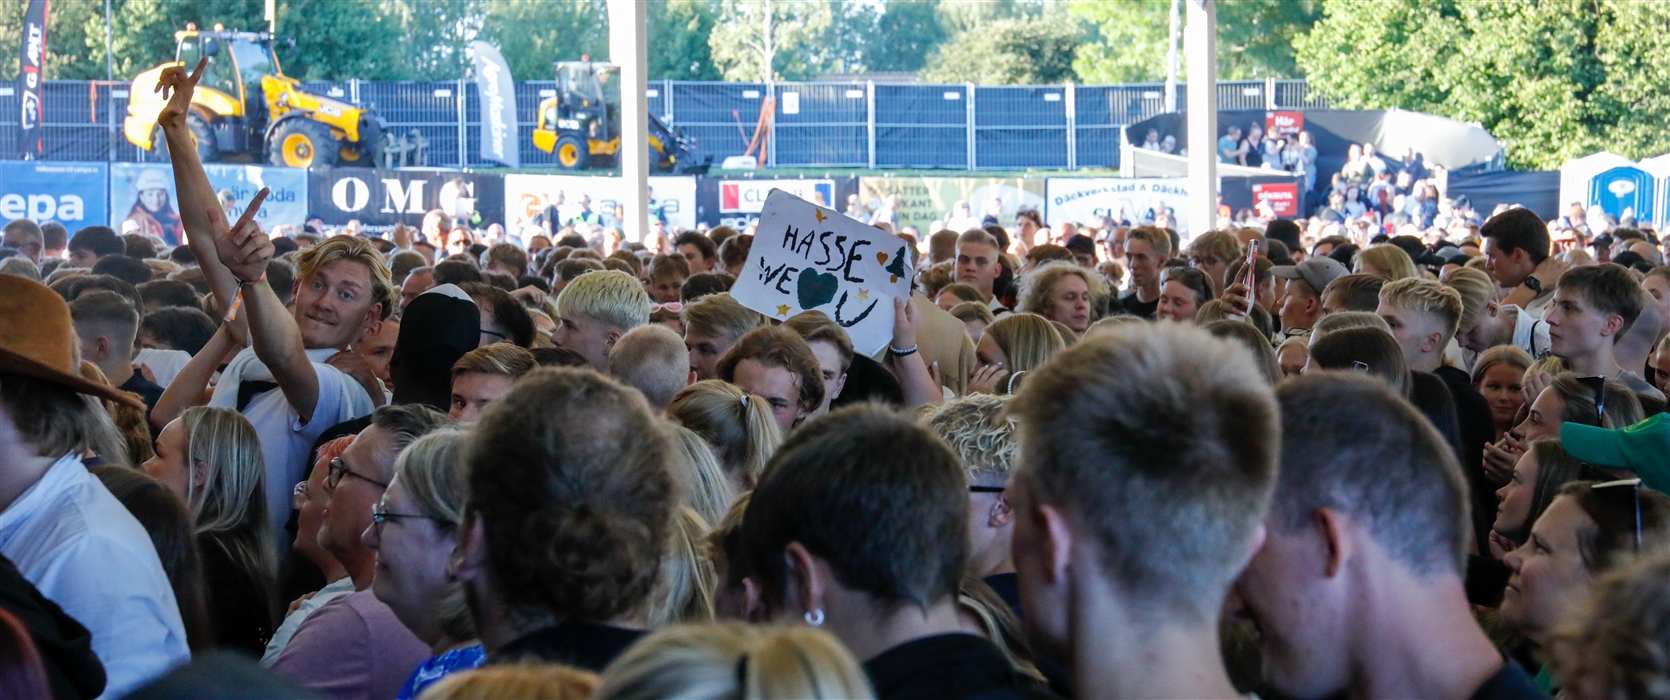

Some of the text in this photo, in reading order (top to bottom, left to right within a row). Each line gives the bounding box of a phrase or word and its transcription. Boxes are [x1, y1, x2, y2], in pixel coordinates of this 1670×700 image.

[318, 104, 342, 118] JCB
[913, 211, 938, 222] DAG
[782, 224, 871, 283] HASSE
[758, 256, 879, 328] WE U
